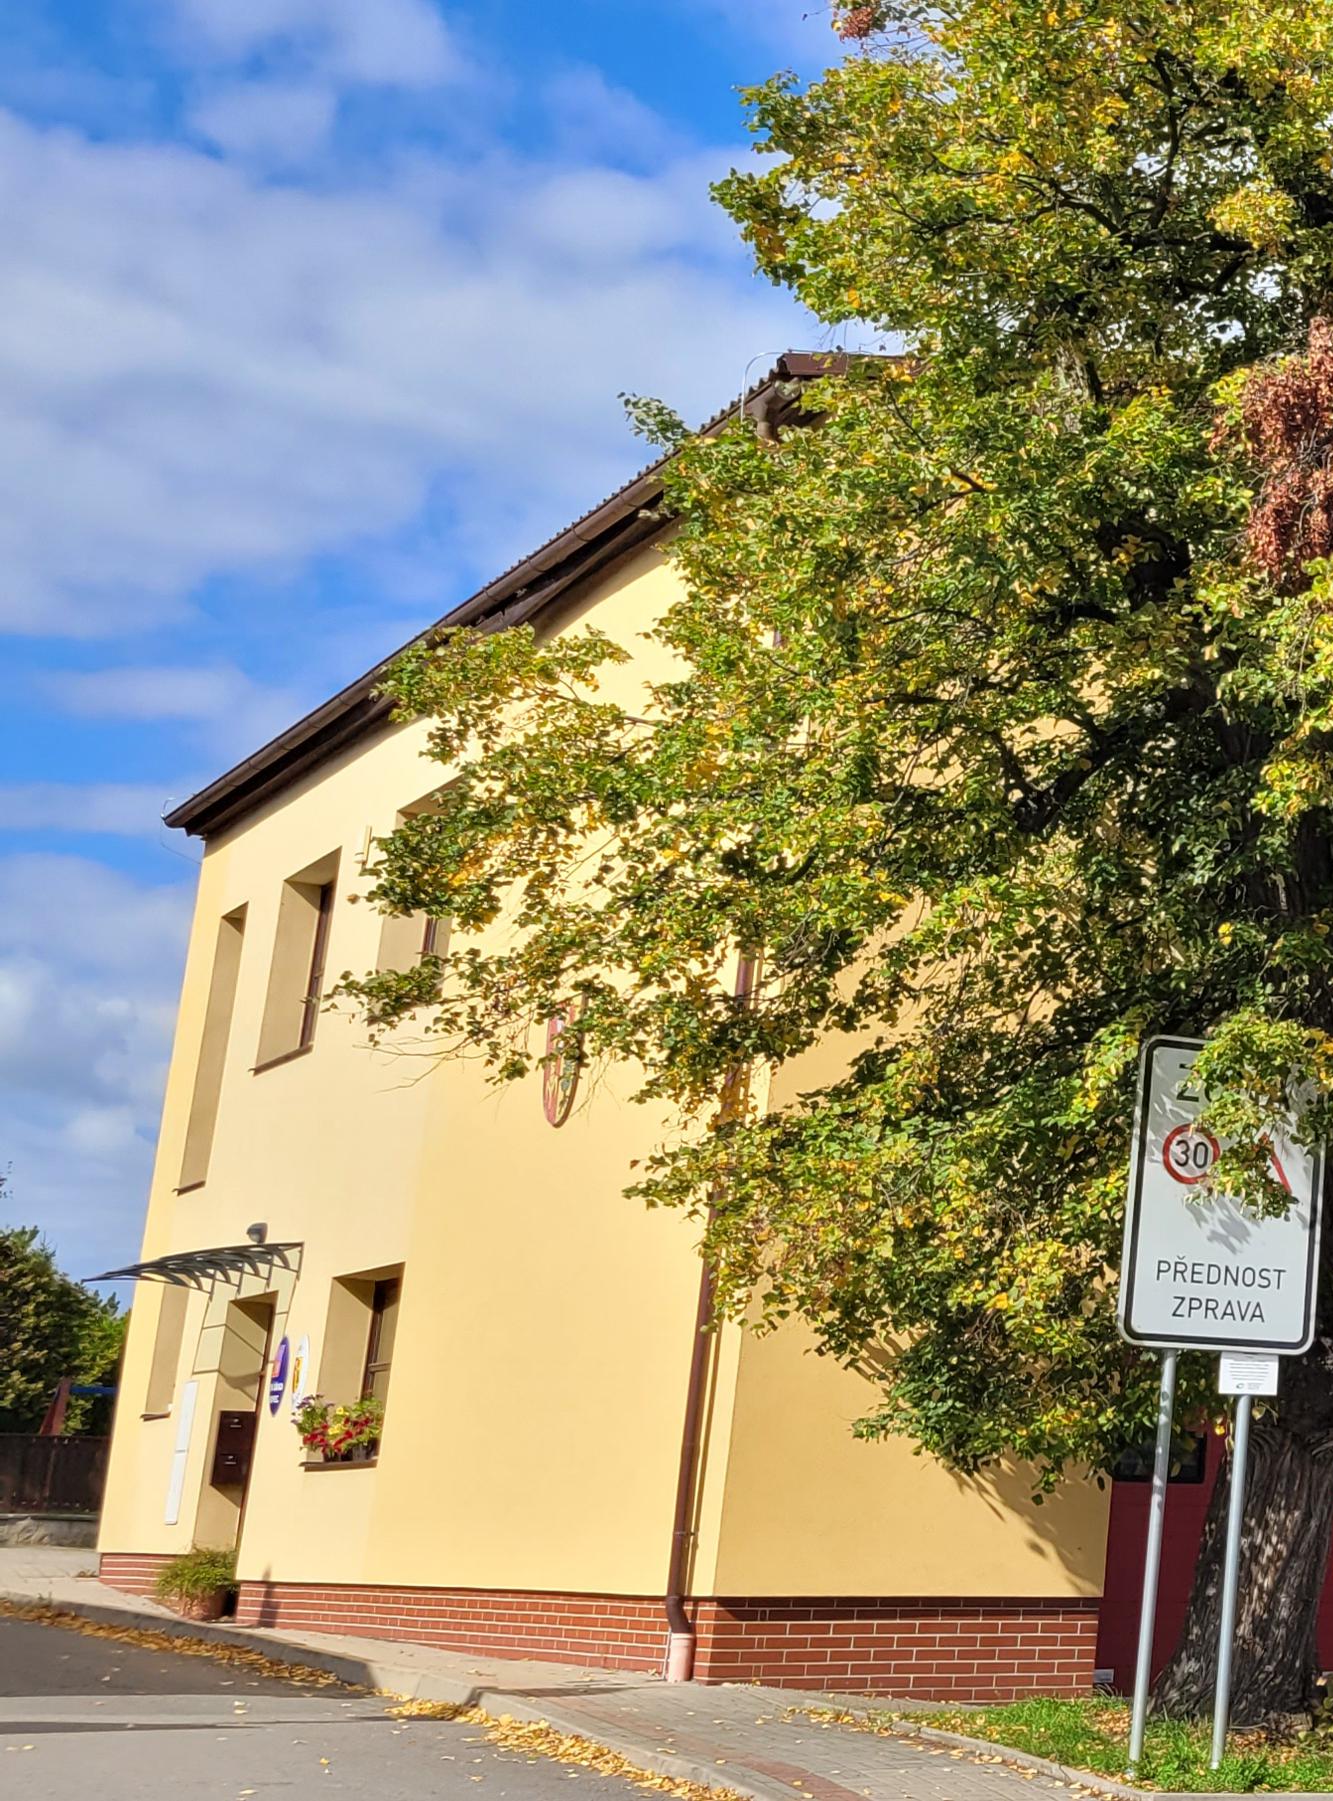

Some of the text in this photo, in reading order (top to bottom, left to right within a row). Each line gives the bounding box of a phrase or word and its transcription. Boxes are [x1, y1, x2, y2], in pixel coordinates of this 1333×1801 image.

[1174, 1139, 1209, 1169] 30
[1156, 1256, 1287, 1290] PŘEDNOST
[1172, 1296, 1265, 1323] ZPRAVA
